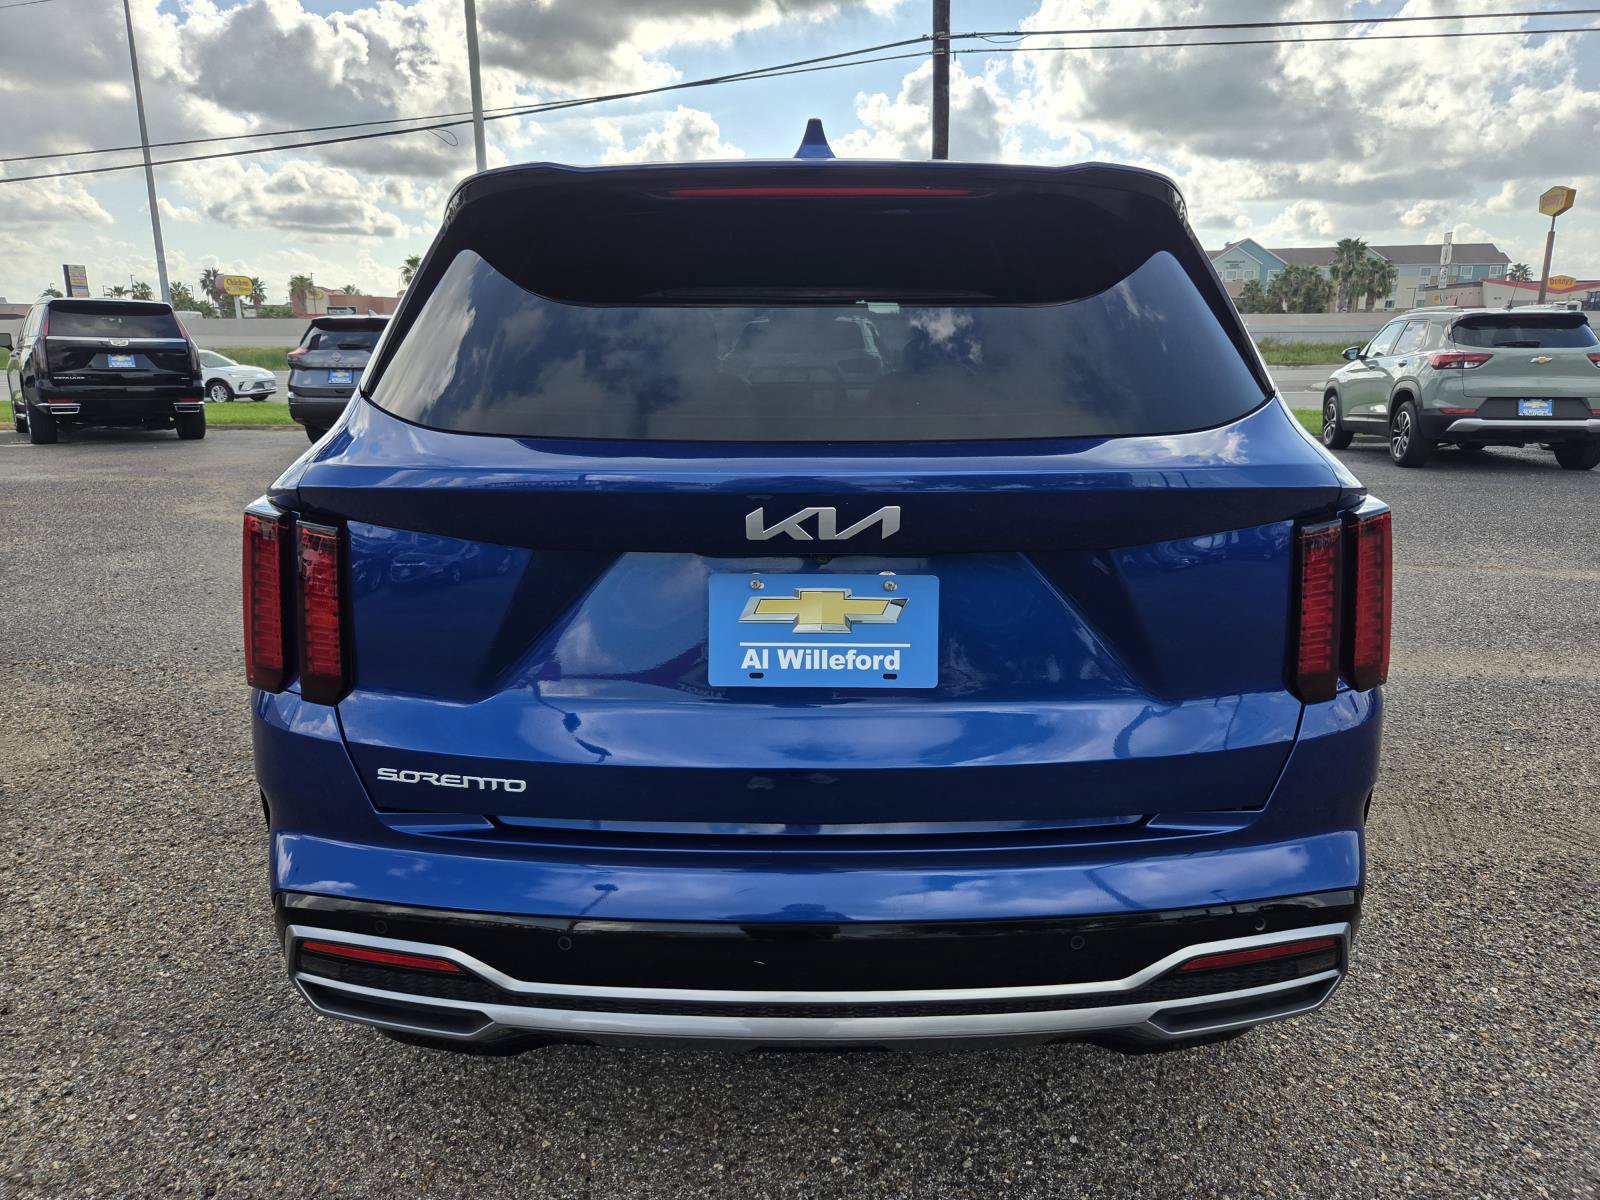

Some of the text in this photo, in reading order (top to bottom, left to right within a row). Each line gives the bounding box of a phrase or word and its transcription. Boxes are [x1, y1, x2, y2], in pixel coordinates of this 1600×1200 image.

[746, 506, 900, 540] KIA
[741, 649, 900, 670] Al Willeford
[377, 768, 527, 792] SORENTO
